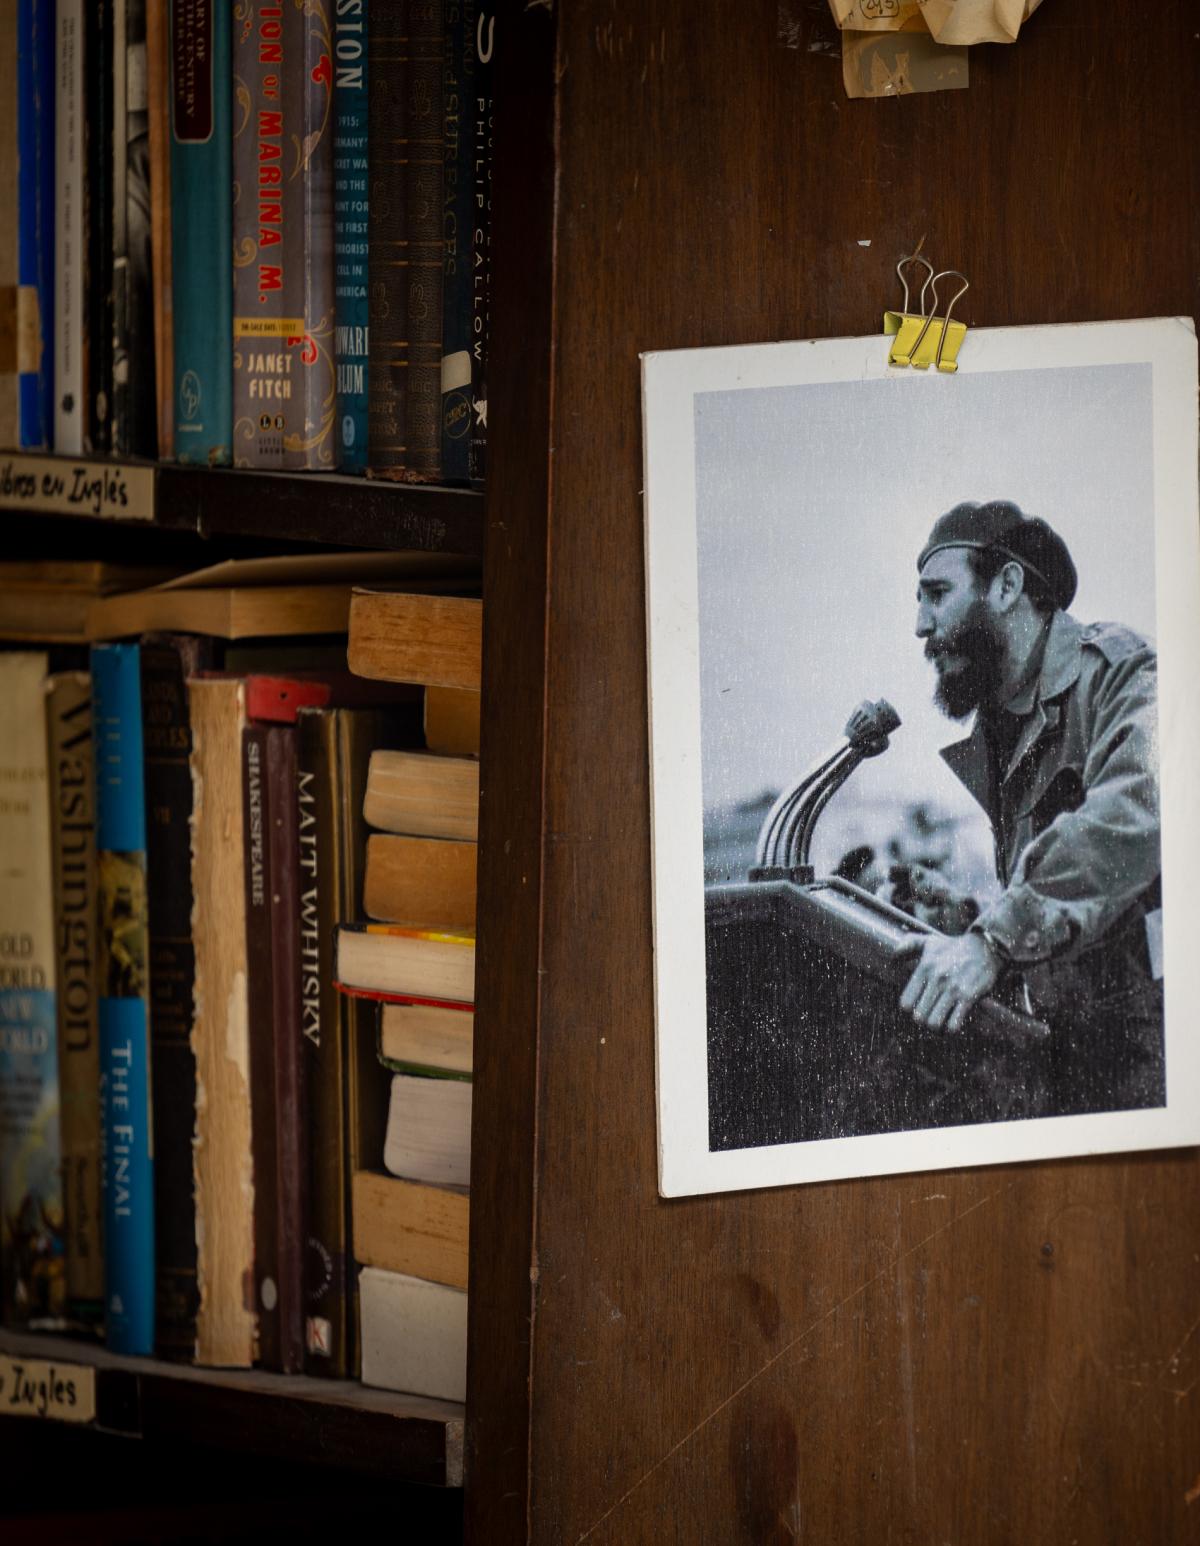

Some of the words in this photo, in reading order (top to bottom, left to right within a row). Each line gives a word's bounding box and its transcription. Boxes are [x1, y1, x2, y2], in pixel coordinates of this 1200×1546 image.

[195, 36, 207, 63] OF
[259, 0, 284, 63] ION
[336, 0, 363, 90] SION
[259, 111, 283, 248] MARINA
[475, 97, 485, 208] PHILIP
[350, 180, 366, 190] THE
[351, 201, 369, 211] FOR
[345, 222, 368, 232] FIRST
[258, 265, 284, 303] M.
[352, 264, 362, 275] IN
[473, 228, 484, 361] CALLOW
[247, 353, 293, 374] JANET
[248, 379, 292, 400] FITCH
[336, 364, 364, 394] BLUM
[42, 474, 64, 496] en
[247, 741, 265, 907] SHAKESPEARE
[299, 770, 317, 877] MALT
[60, 699, 95, 1054] Washington
[301, 887, 321, 1049] WHISKY
[111, 1039, 133, 1112] THE
[112, 1123, 135, 1221] FINAL
